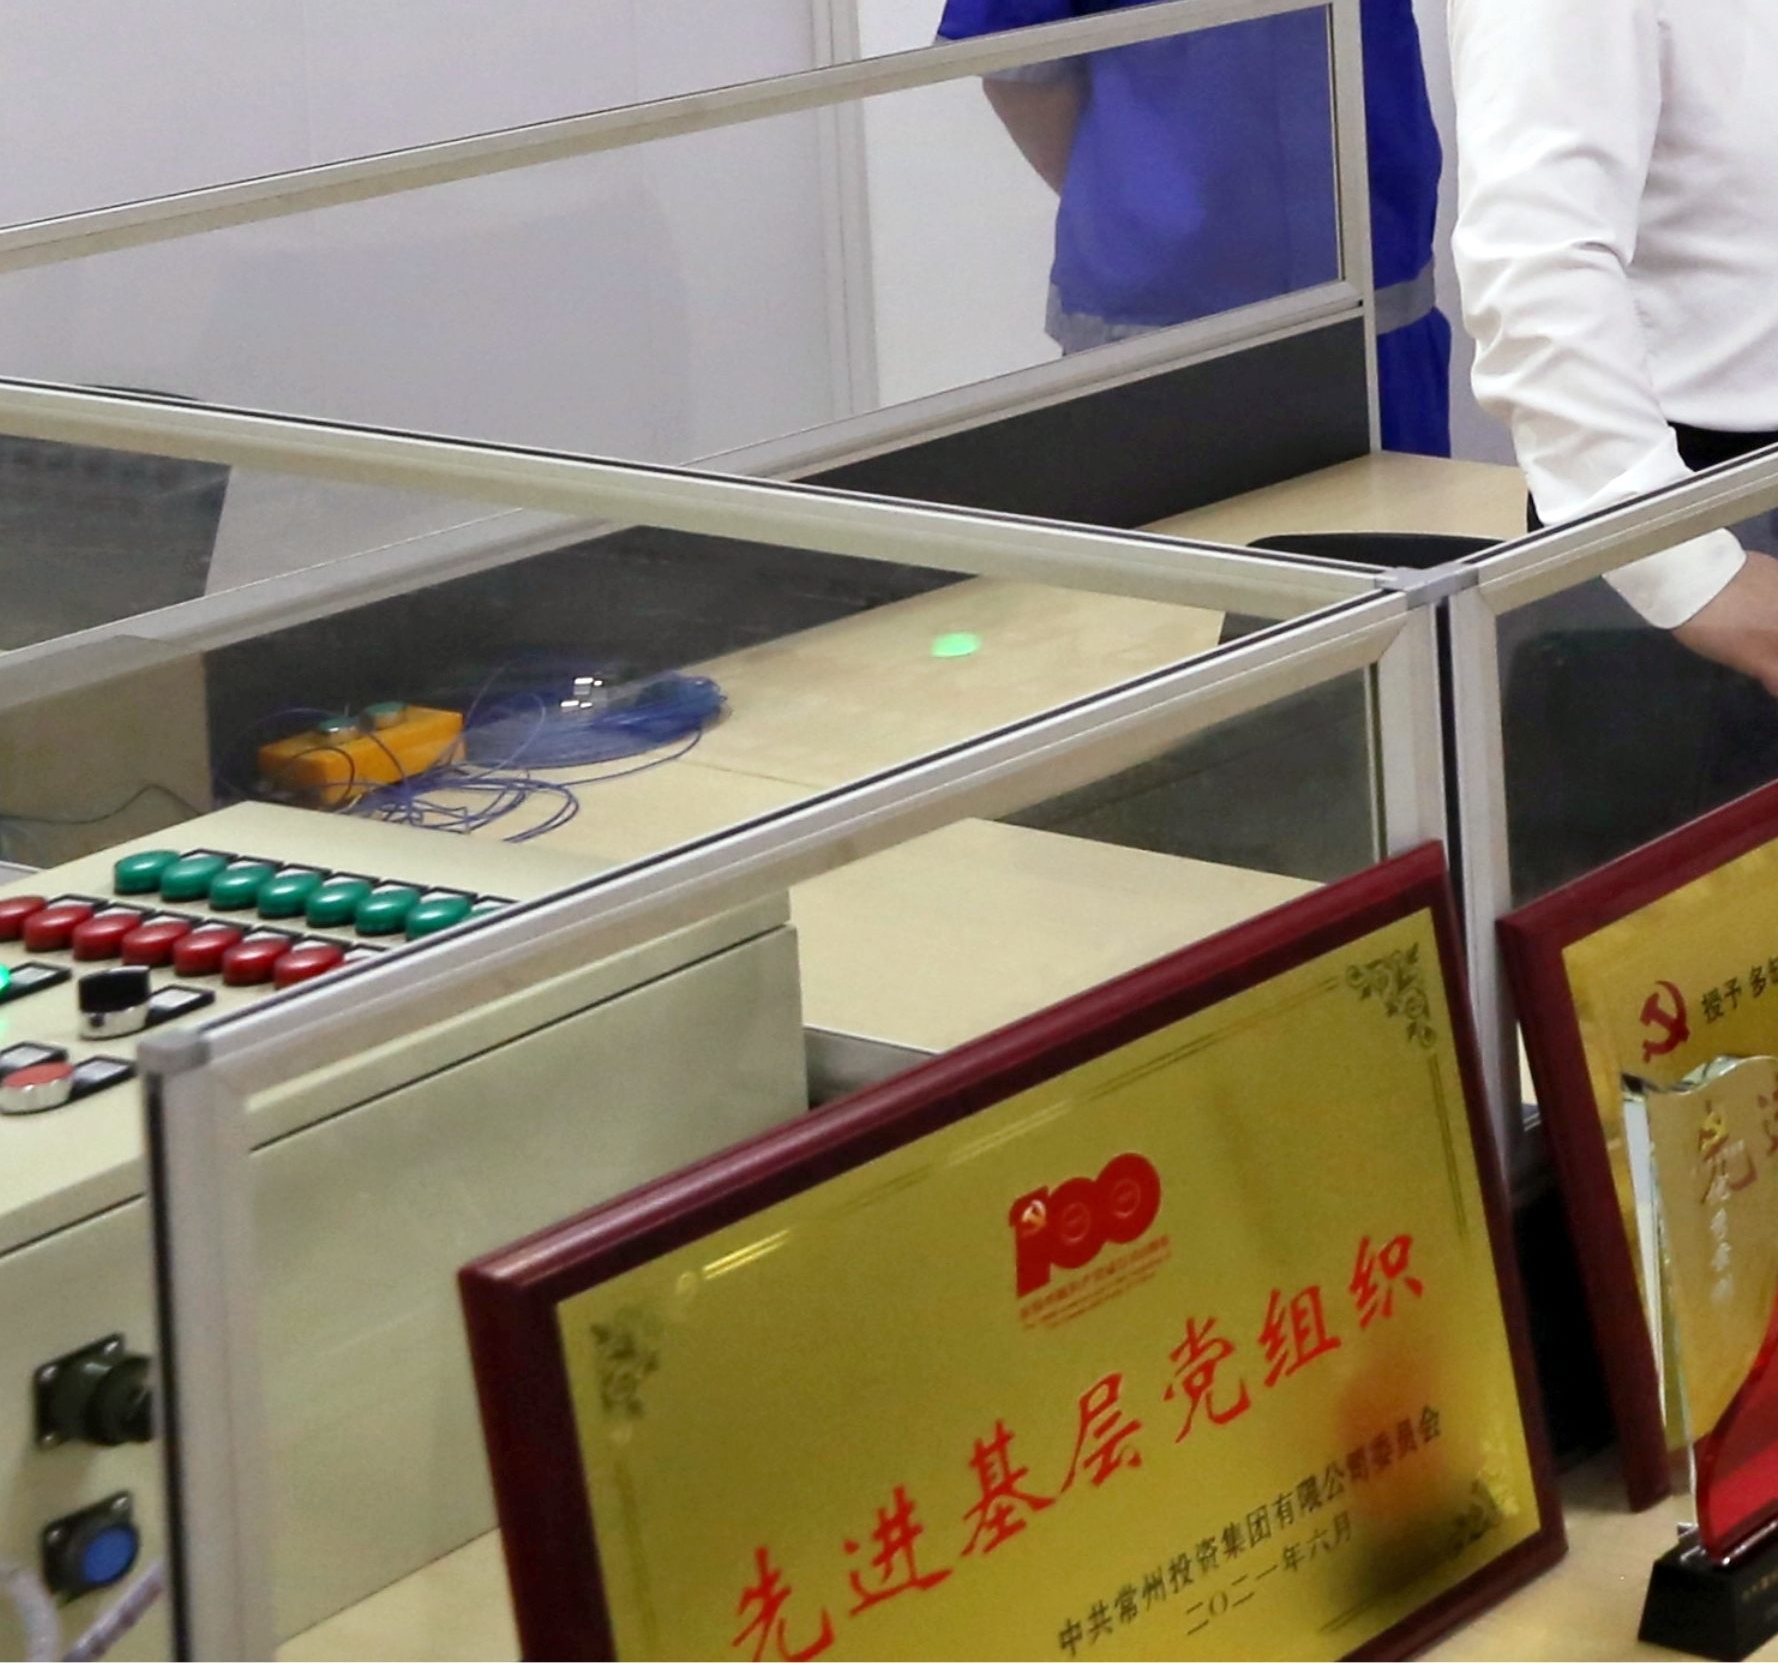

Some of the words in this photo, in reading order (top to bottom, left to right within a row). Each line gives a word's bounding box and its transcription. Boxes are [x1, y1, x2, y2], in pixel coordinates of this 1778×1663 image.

[732, 1234, 1424, 1663] 先进基层党组织
